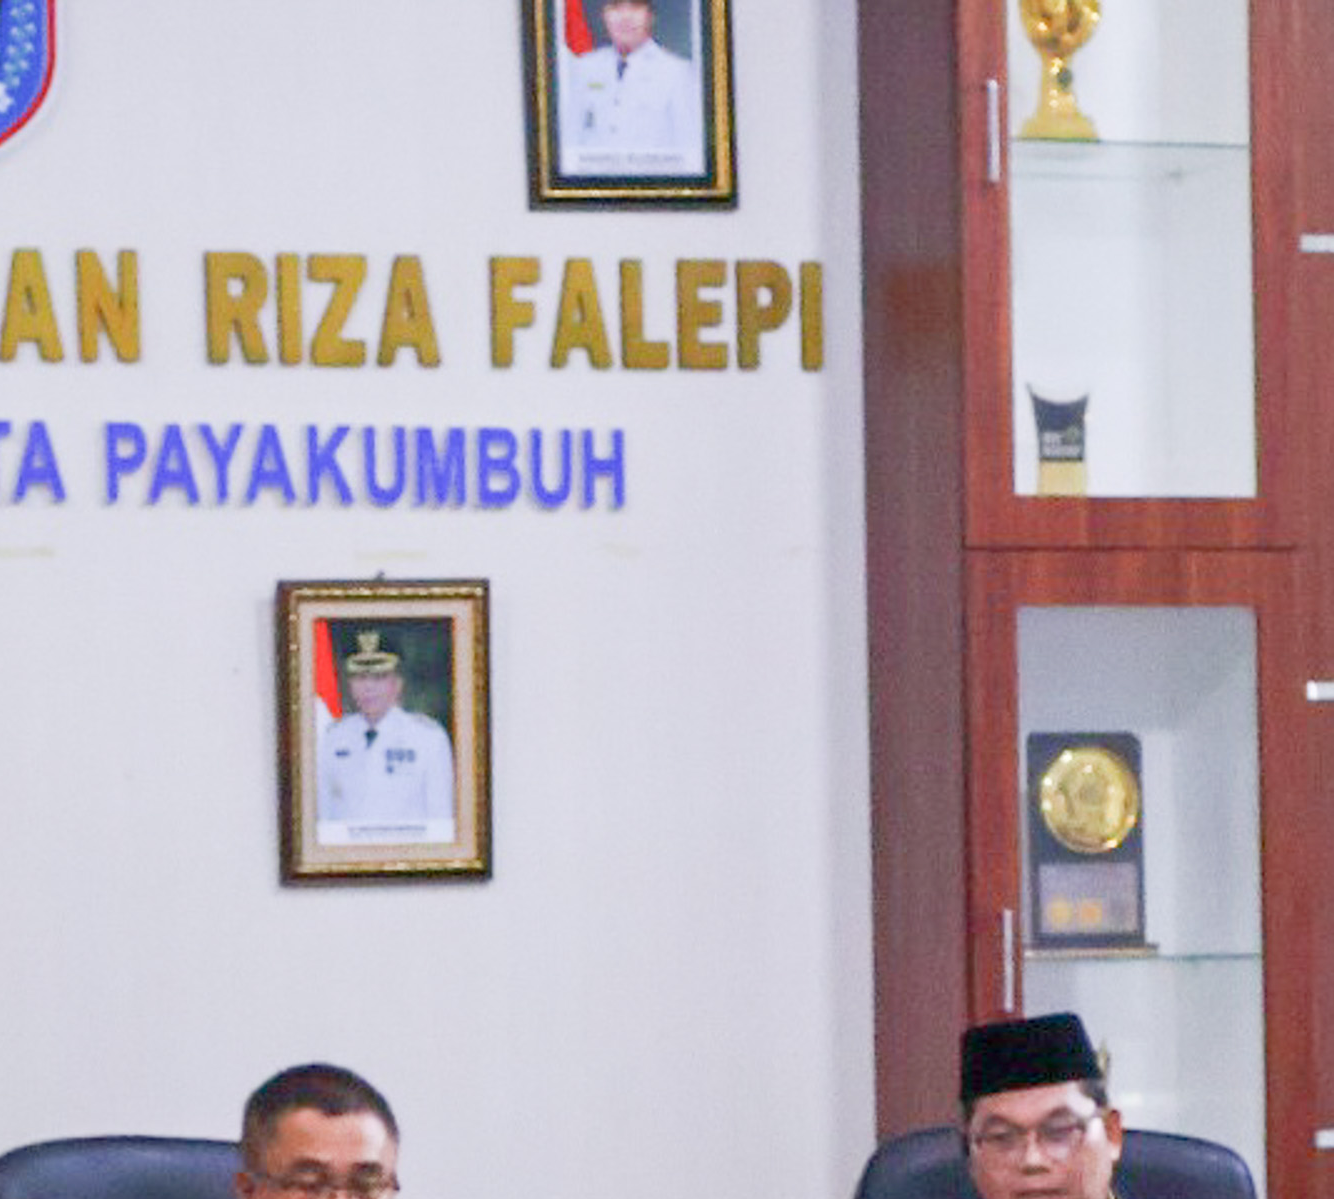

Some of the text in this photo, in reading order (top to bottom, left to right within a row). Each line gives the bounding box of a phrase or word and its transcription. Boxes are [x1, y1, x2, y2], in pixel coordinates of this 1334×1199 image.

[205, 251, 440, 369] RIZA
[488, 255, 825, 371] FALEPI
[104, 421, 626, 510] PAYAKUMBUH
